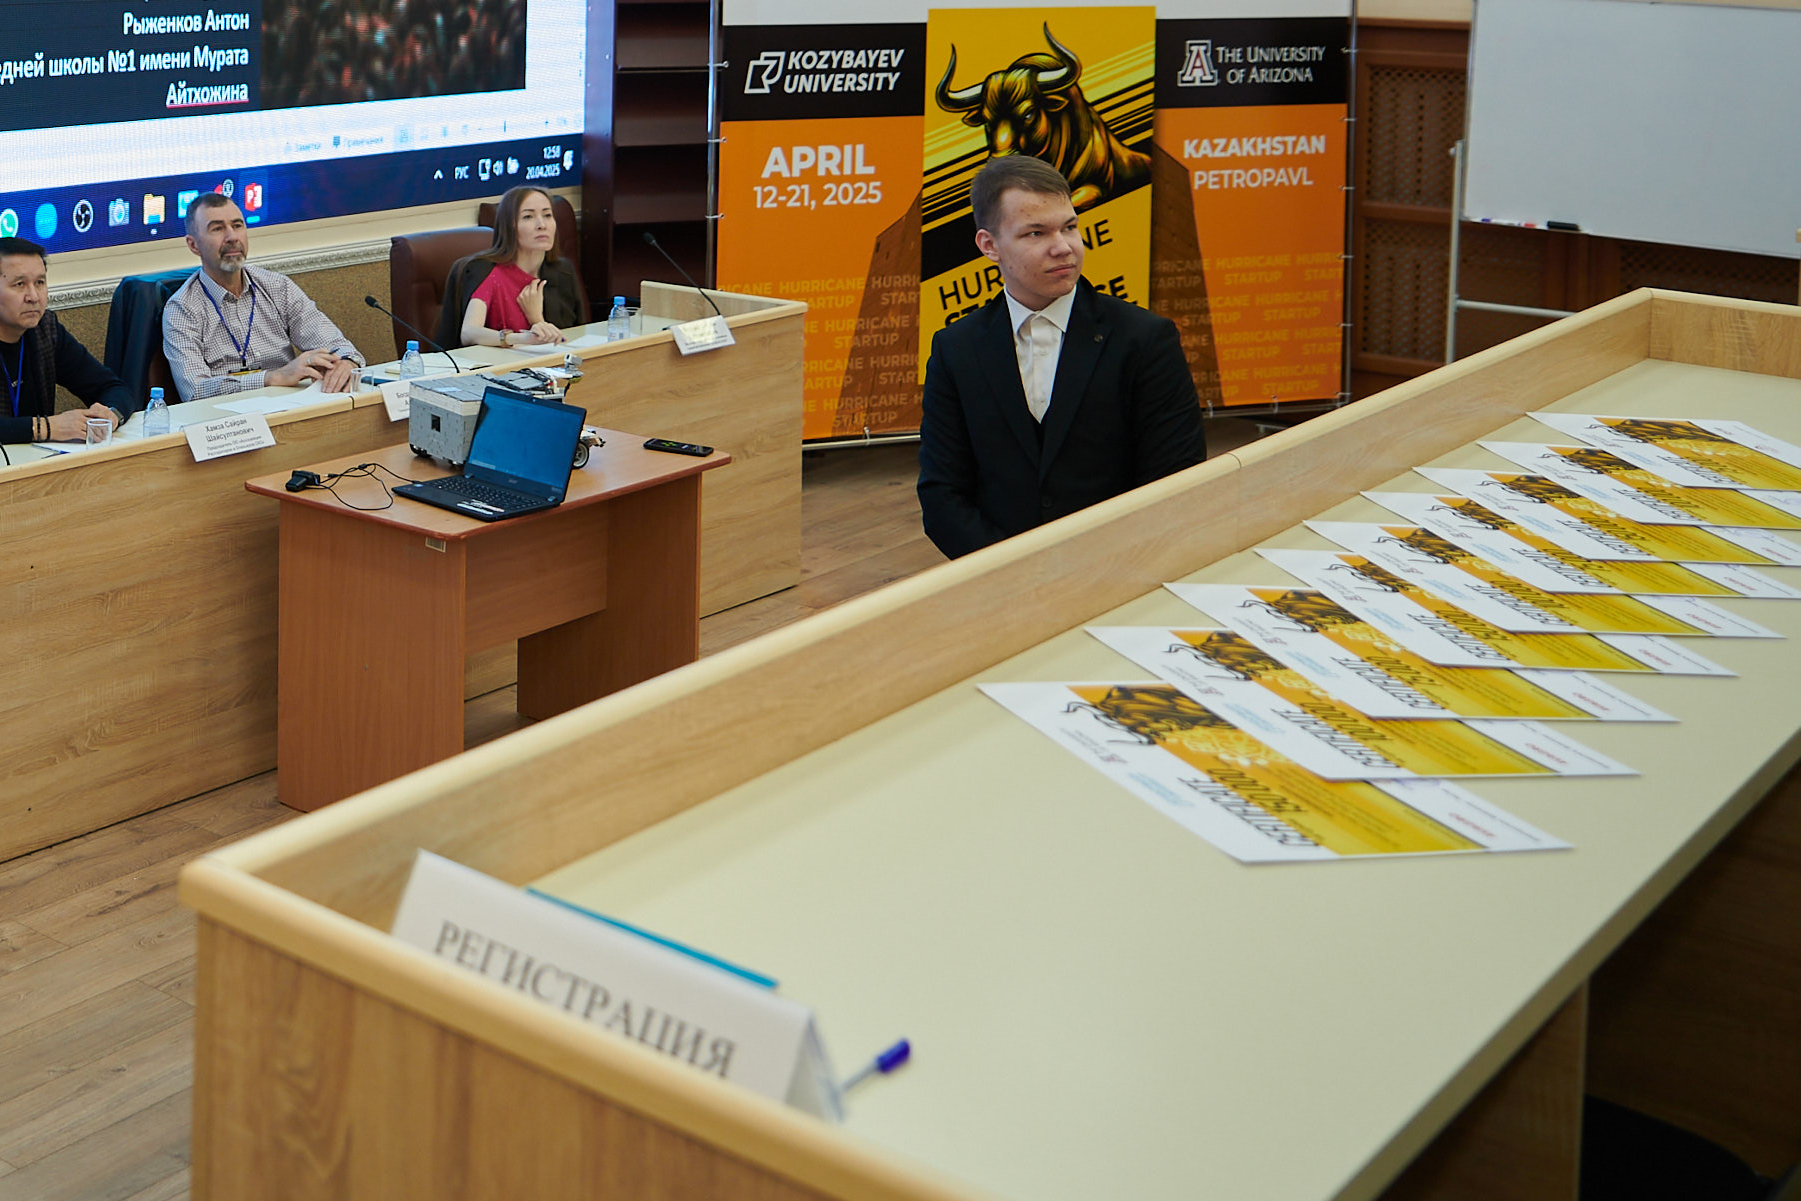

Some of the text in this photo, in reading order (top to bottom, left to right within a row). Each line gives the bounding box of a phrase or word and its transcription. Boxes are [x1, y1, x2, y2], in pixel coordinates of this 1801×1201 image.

[123, 9, 249, 36] Рыженков Антон
[49, 55, 104, 75] школы
[107, 50, 136, 74] №1
[139, 51, 190, 71] имени
[193, 45, 249, 73] Мурата
[787, 49, 905, 70] KOZYBAYEV
[1177, 40, 1218, 87] A
[1216, 45, 1326, 63] THE UNIVERSITY
[783, 71, 901, 94] UNIVERSITY
[1226, 66, 1314, 84] OF ARIZONA
[166, 80, 248, 106] Айтхожина
[1183, 135, 1326, 159] KAZAKHSTAN
[526, 163, 560, 180] 20.04.2025
[761, 144, 876, 178] APRIL
[455, 166, 469, 180] РУС
[1193, 167, 1314, 190] PETROPAVL
[753, 181, 883, 211] 12-21, 2025
[779, 278, 865, 294] HURRICANE
[807, 295, 855, 310] ARTUP
[825, 315, 910, 333] HURRICANE
[833, 333, 899, 349] STARTUP
[804, 374, 853, 391] ARTUP
[434, 919, 738, 1079] РЕГИСТРАЦИЯ
